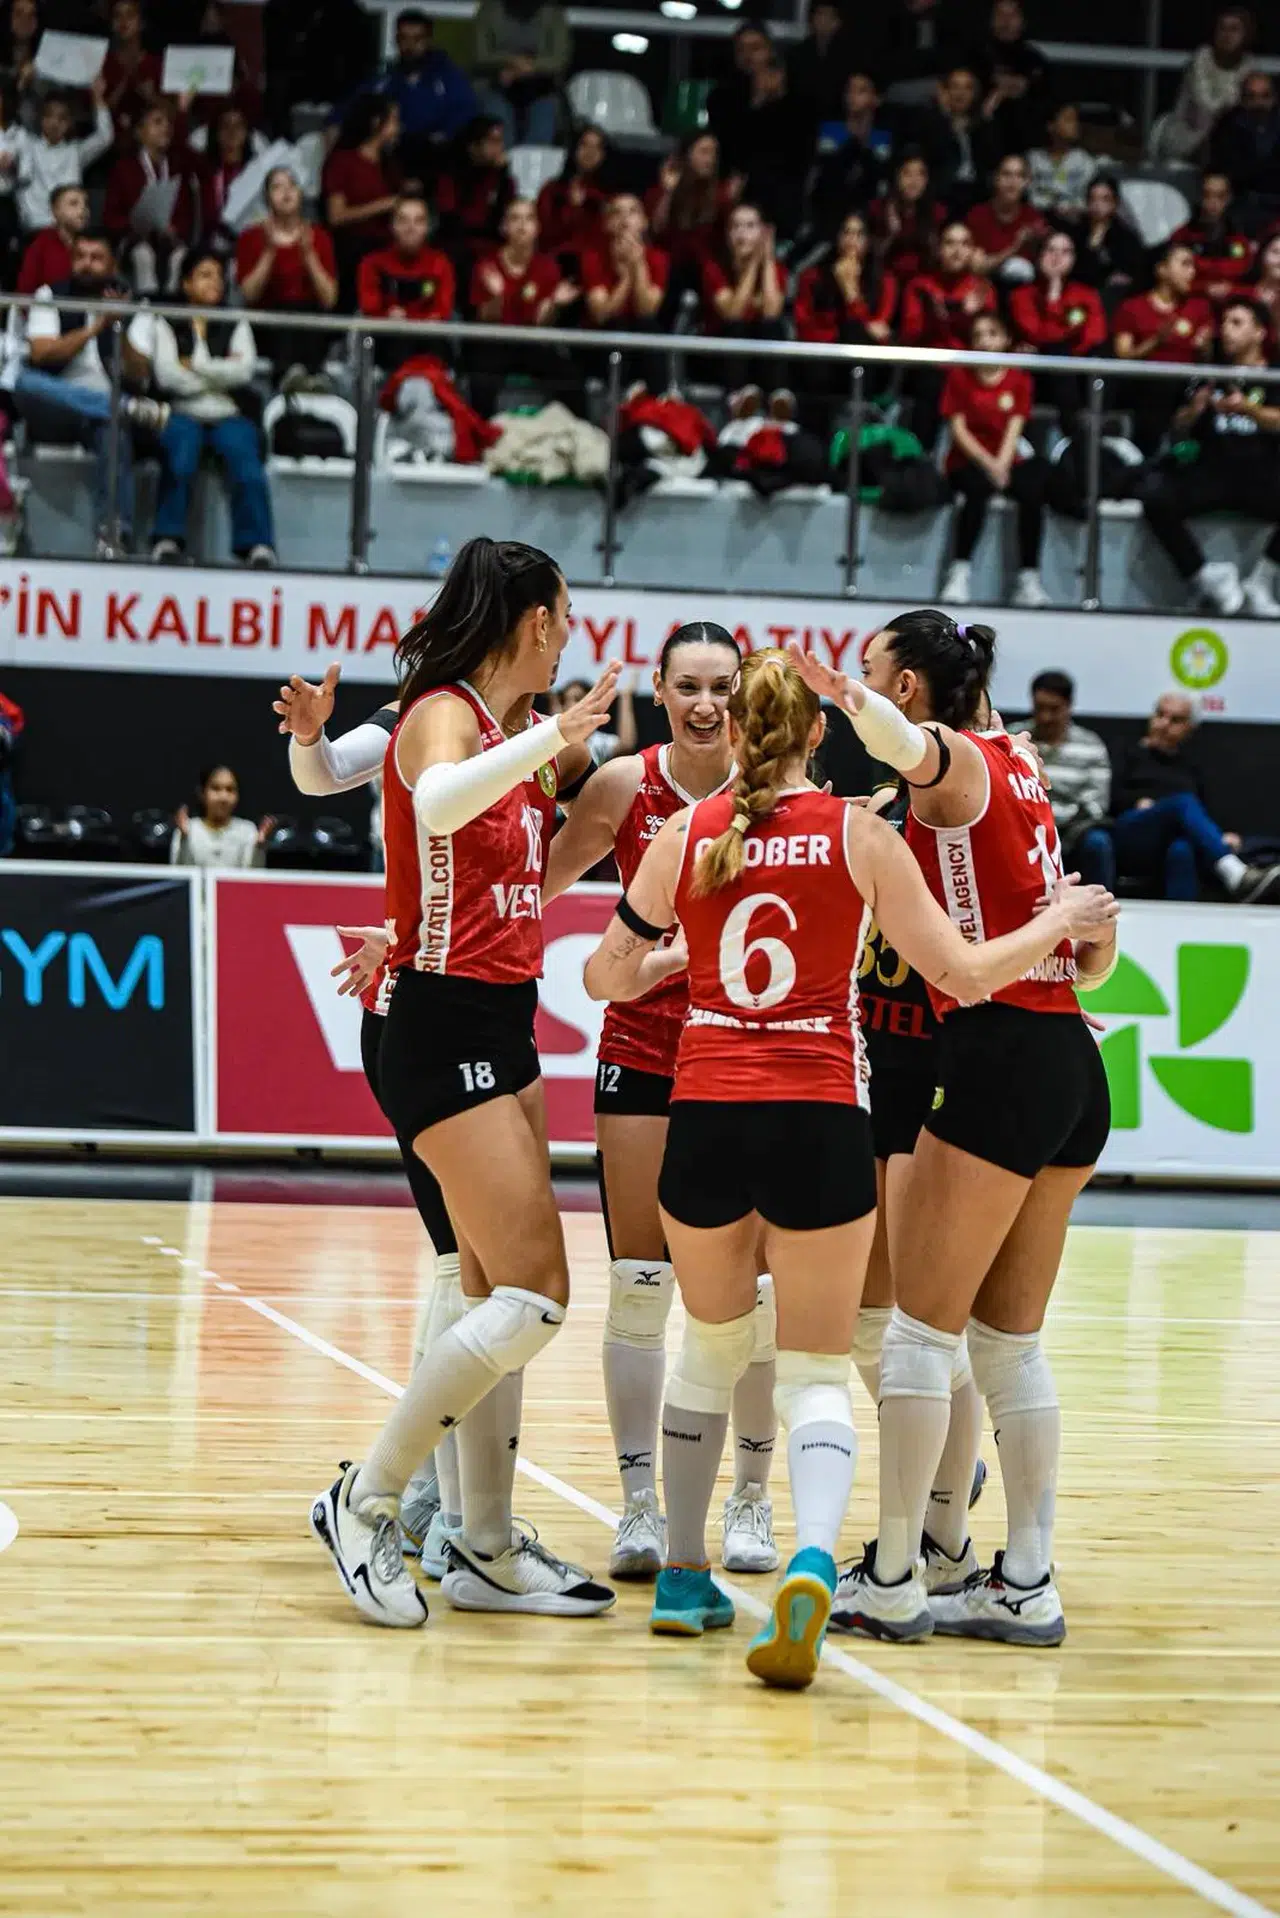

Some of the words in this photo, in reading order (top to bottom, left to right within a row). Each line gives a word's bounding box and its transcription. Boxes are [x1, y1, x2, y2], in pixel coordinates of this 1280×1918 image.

[105, 588, 282, 650] KALBİ
[947, 843, 974, 910] AGENCY
[719, 892, 797, 1010] 6
[458, 1061, 496, 1092] 18
[600, 1064, 622, 1092] 12
